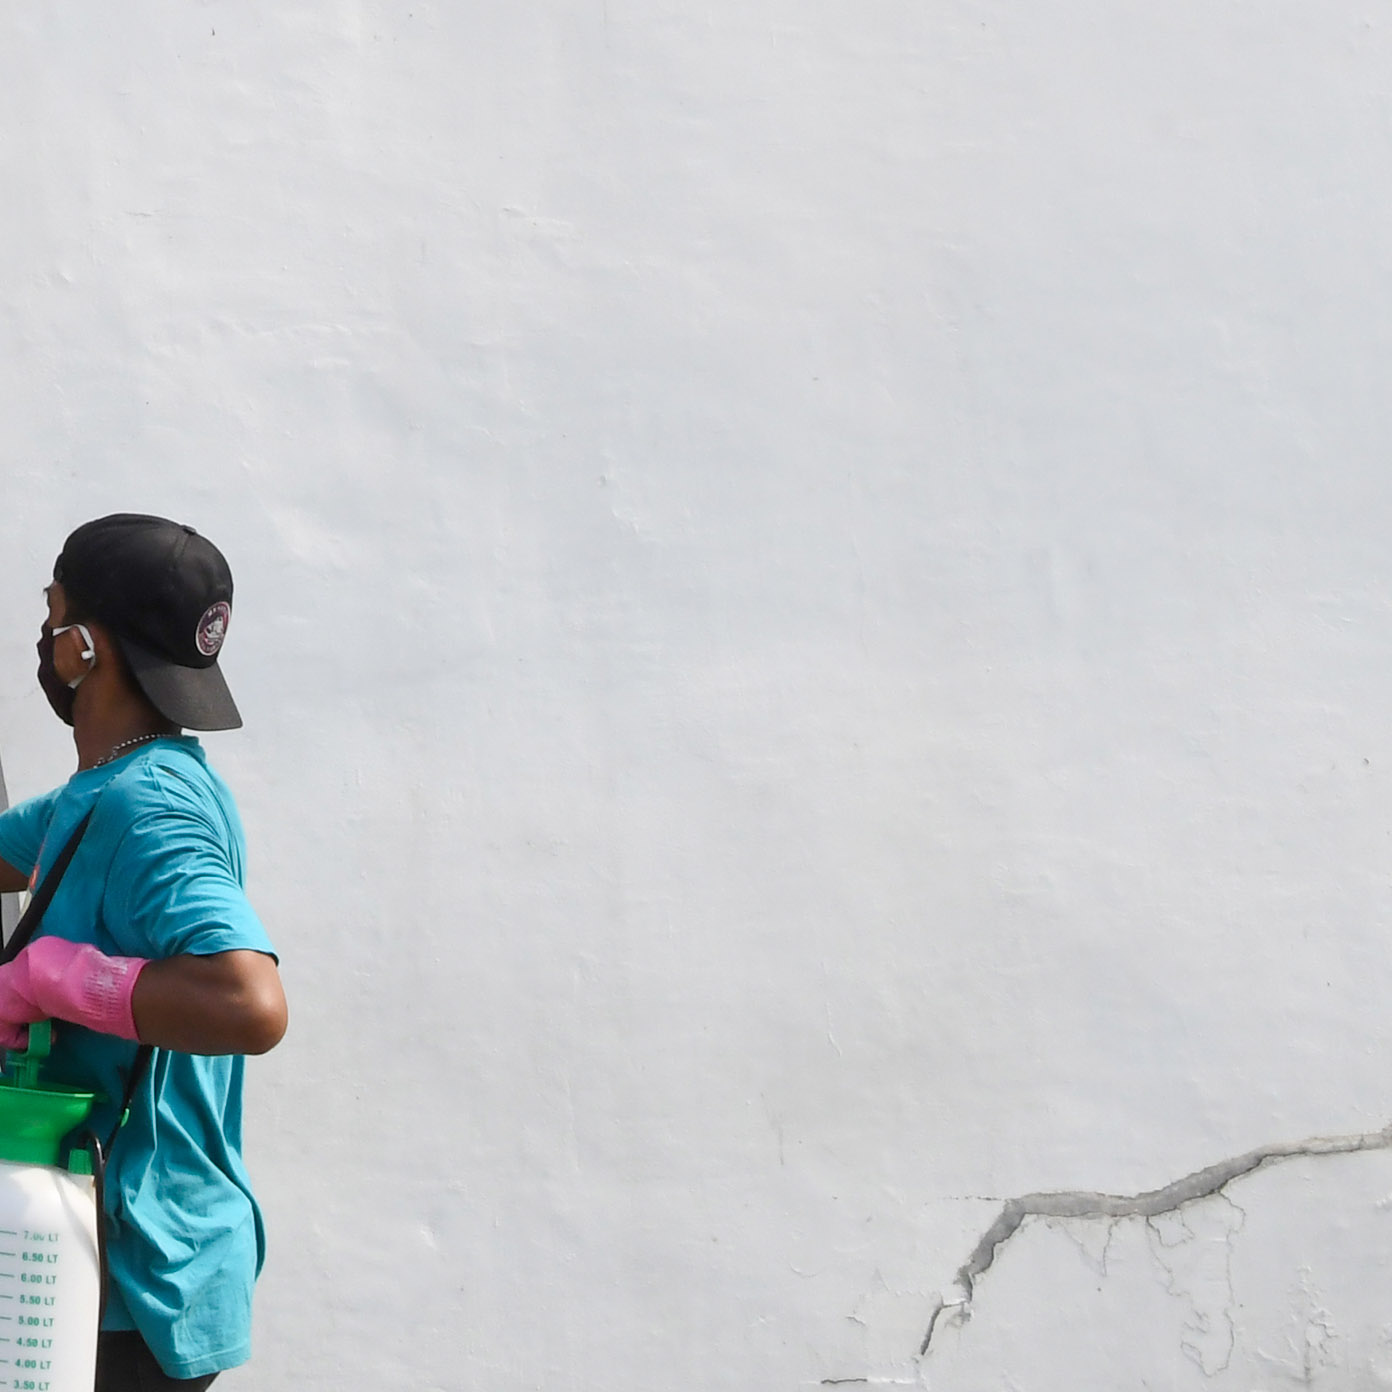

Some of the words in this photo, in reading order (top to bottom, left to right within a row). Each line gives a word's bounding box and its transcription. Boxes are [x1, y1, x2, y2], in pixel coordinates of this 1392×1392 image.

[48, 1233, 60, 1242] LT
[22, 1251, 44, 1263] 6.50
[46, 1254, 58, 1263] LT
[20, 1272, 43, 1284] 6.00
[45, 1275, 57, 1285] LT
[19, 1294, 42, 1305] 5.50
[44, 1296, 56, 1306] LT
[18, 1315, 40, 1327] 5.00
[42, 1317, 55, 1327] LT
[16, 1337, 39, 1348] 4.50
[41, 1339, 53, 1349] LT
[14, 1358, 37, 1369] 4.00
[39, 1360, 52, 1370] LT
[38, 1382, 51, 1392] LT
